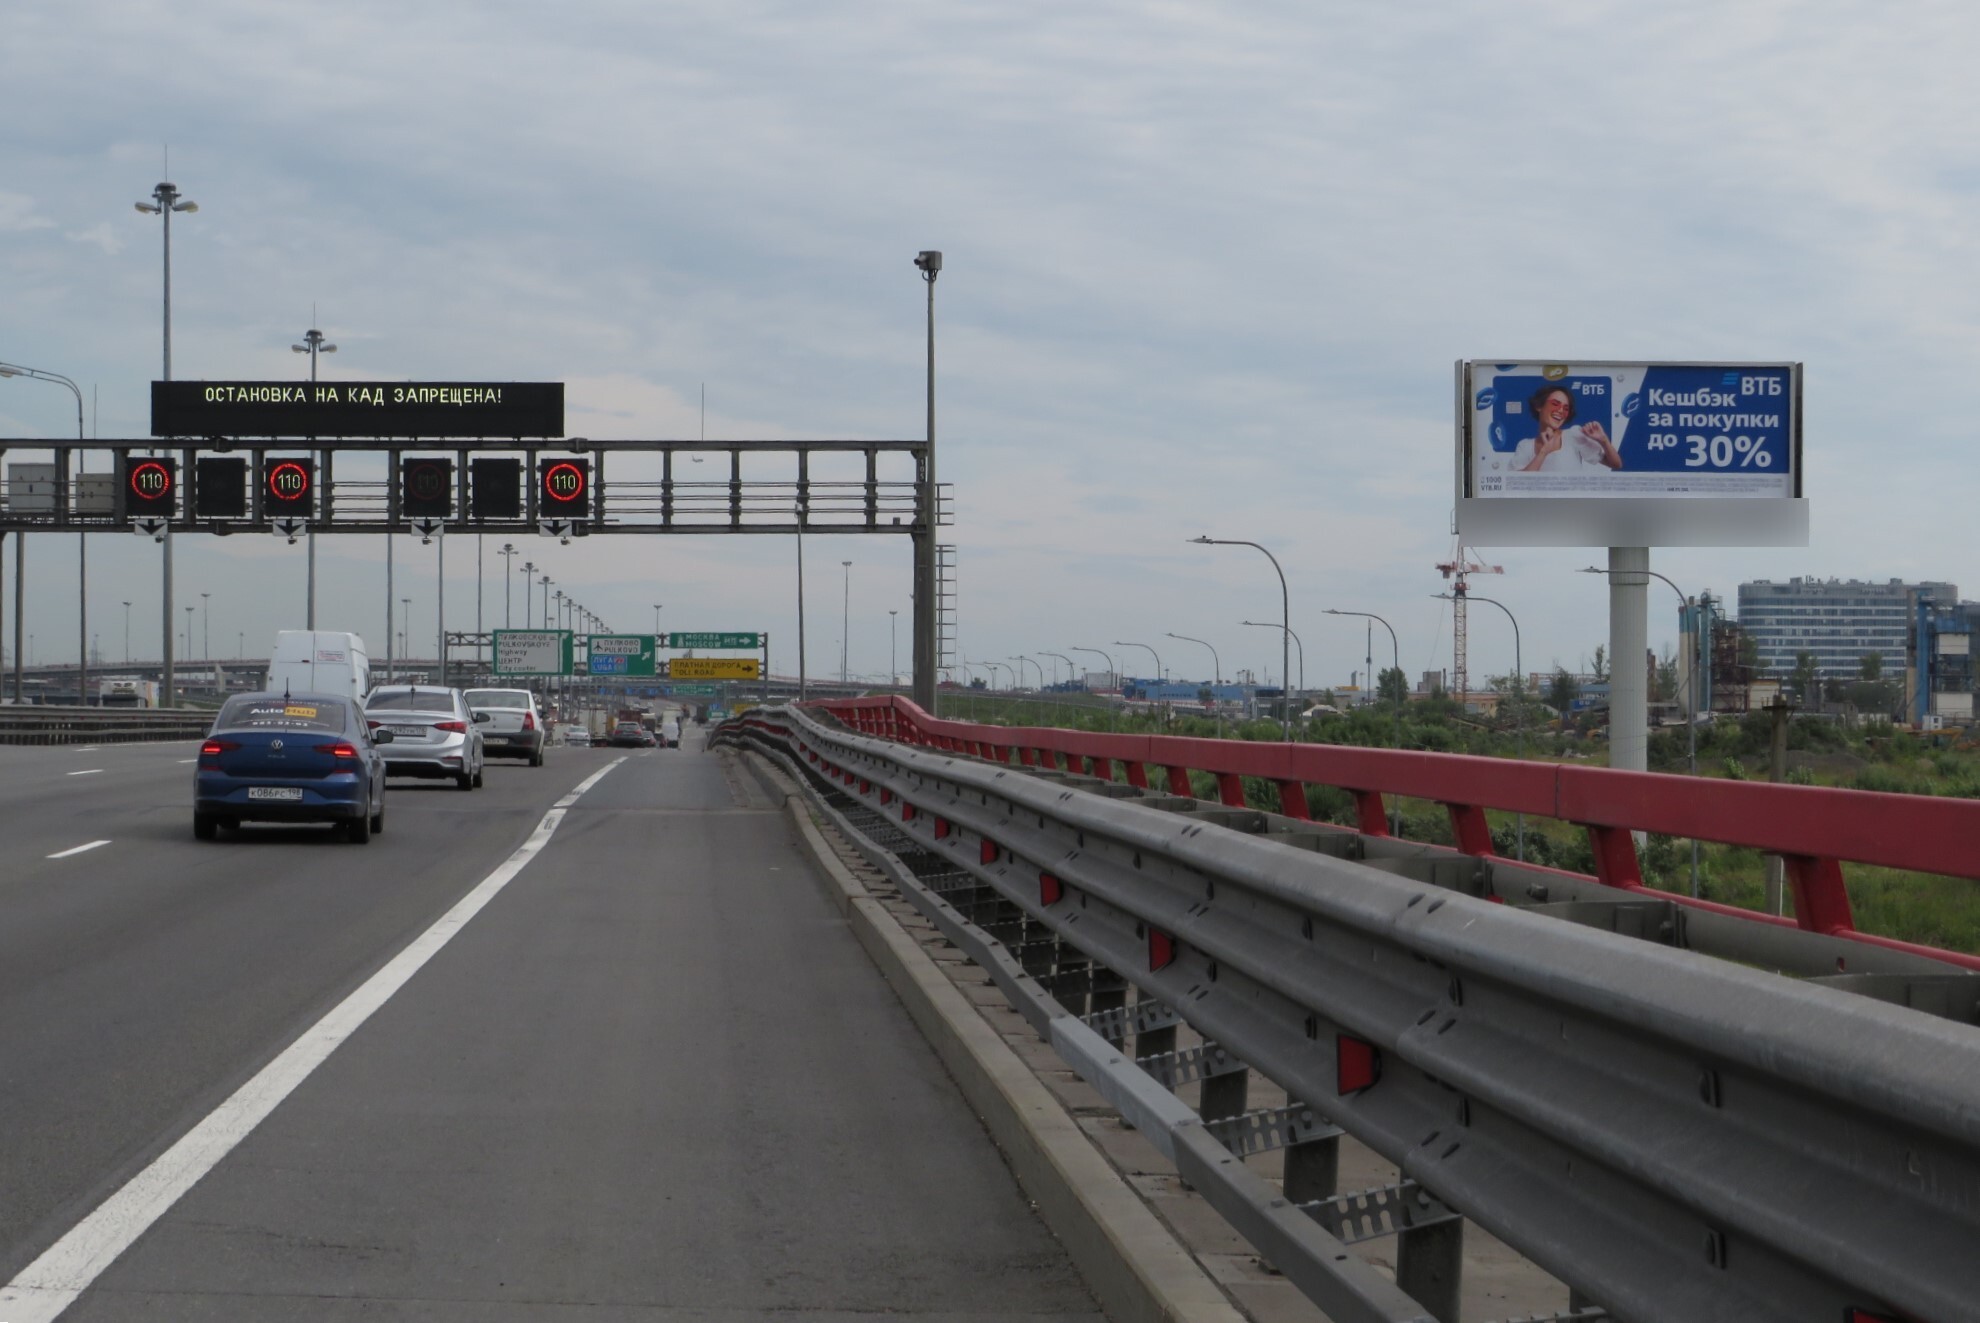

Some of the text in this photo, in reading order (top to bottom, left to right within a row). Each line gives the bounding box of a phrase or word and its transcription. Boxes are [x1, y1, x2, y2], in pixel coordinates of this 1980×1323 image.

[1582, 384, 1604, 395] ВТБ
[1741, 377, 1782, 395] ВТБ
[205, 386, 502, 407] ОСТАНОВКА НА КАД ЗАПРЕЩЕНА!
[1648, 388, 1736, 407] Кешбэк
[1648, 413, 1779, 432] за покупки
[1648, 433, 1772, 468] до 30%
[140, 473, 163, 489] 110
[278, 474, 301, 490] 110
[553, 474, 576, 490] 110
